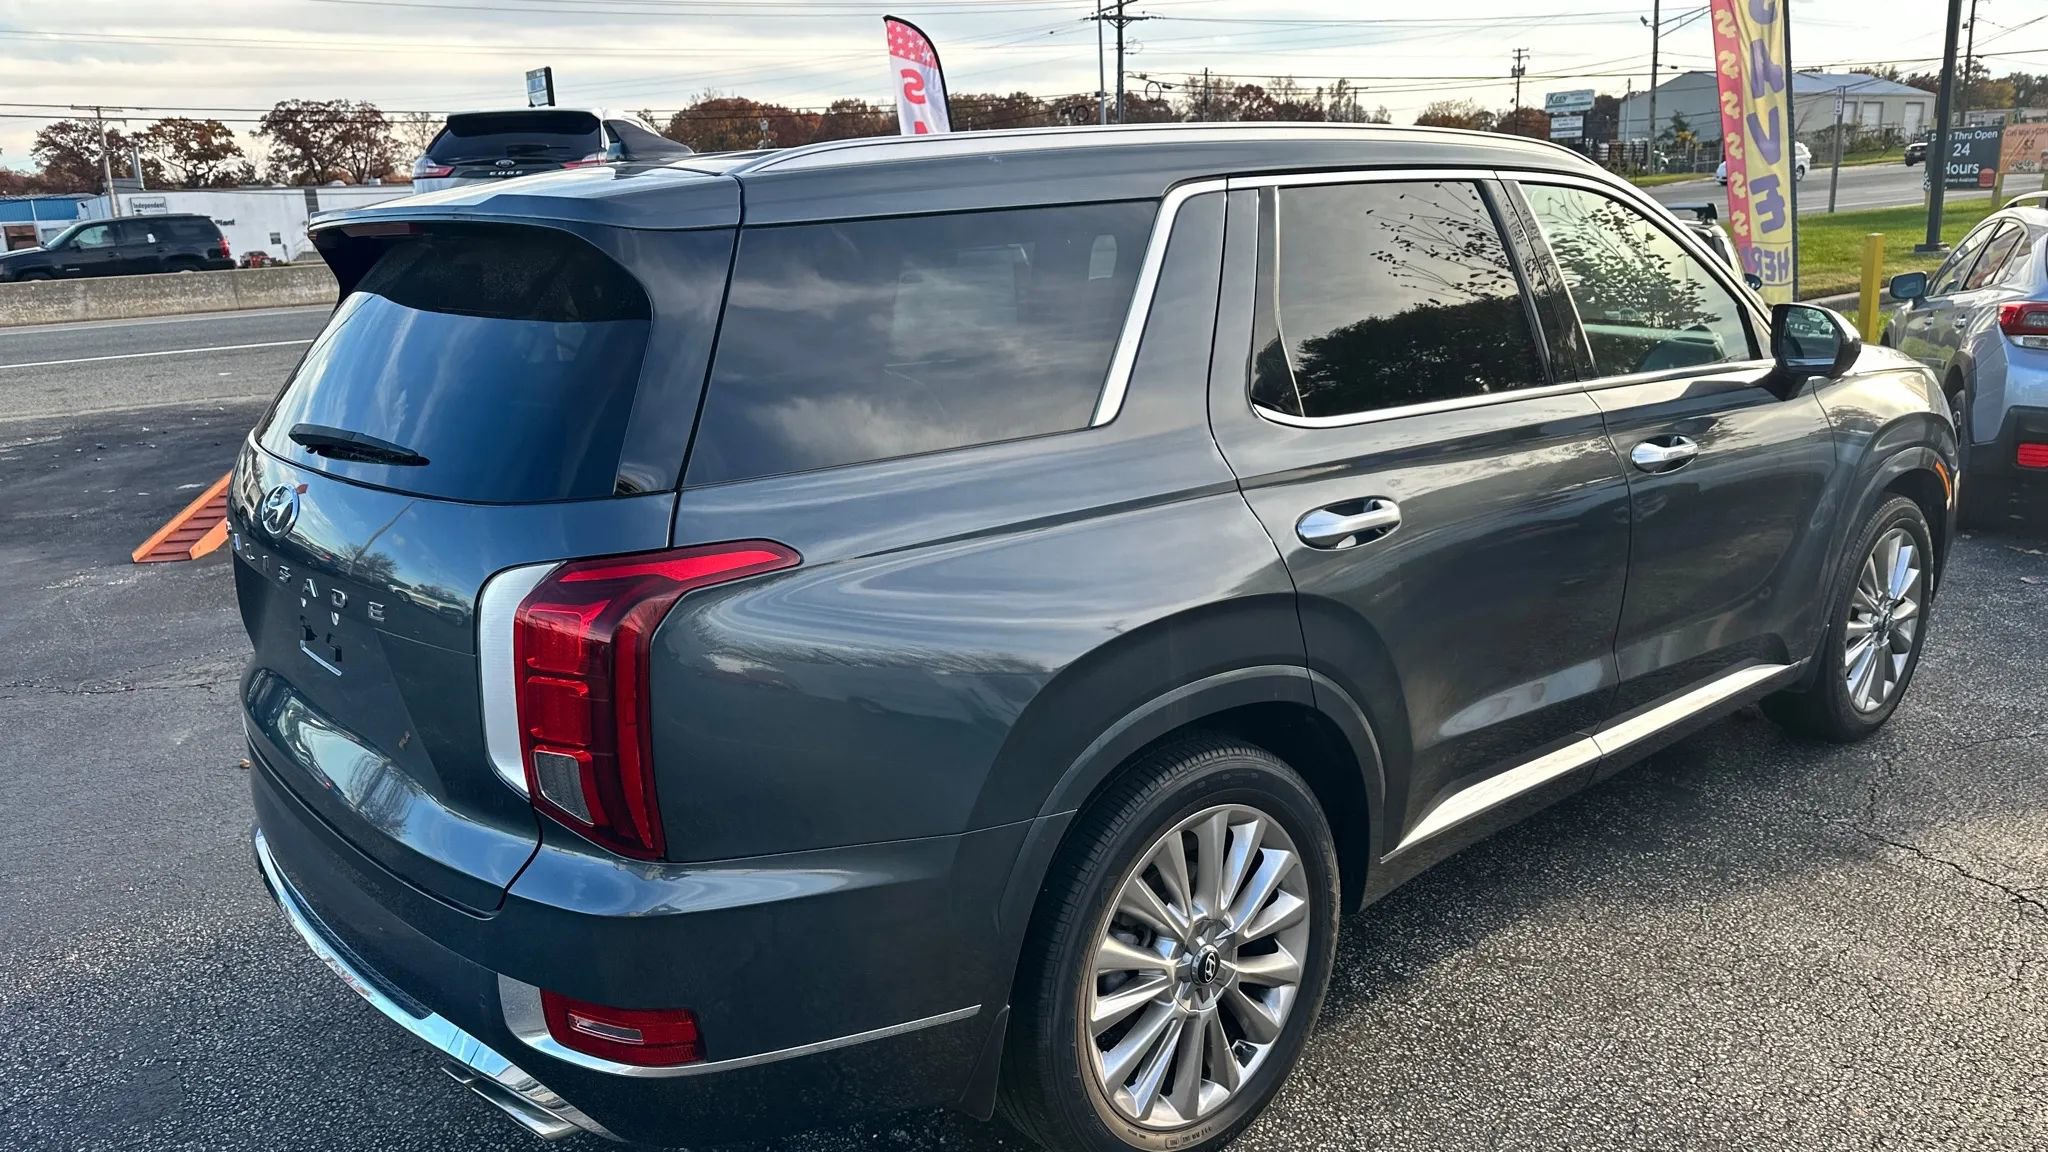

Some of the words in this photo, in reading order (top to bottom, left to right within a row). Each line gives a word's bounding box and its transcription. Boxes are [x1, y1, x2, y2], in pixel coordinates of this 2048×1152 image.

[1954, 132, 1972, 140] Thru
[1974, 130, 1998, 140] Open
[1952, 143, 1970, 156] 24
